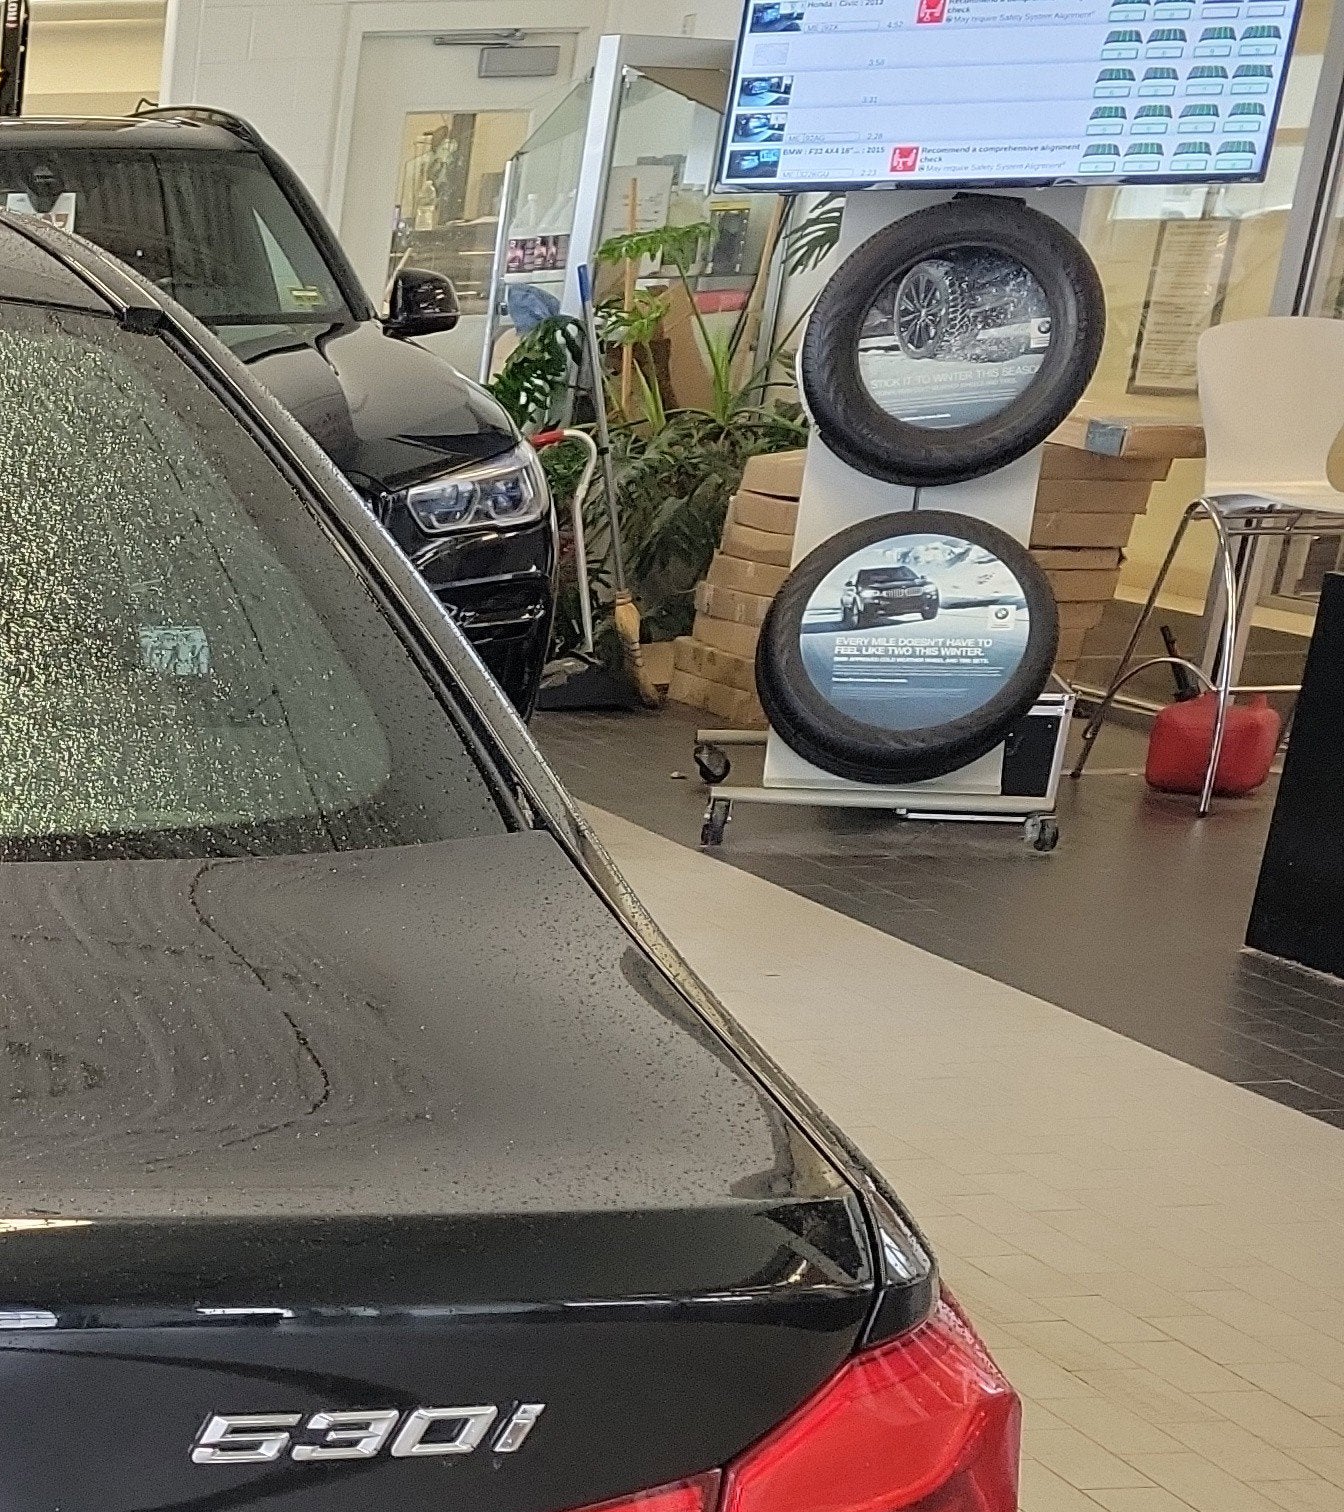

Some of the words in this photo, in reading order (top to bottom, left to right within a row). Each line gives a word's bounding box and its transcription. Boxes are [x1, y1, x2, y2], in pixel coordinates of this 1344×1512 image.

[979, 145, 1039, 154] comprehensive
[1041, 143, 1081, 152] alignment
[871, 378, 900, 390] STICK
[916, 375, 932, 385] TO
[935, 371, 973, 383] WINTER
[977, 368, 1000, 379] THIS
[836, 637, 871, 646] EVERY
[871, 638, 896, 646] MILE
[898, 638, 945, 646] DOESN'T
[946, 638, 976, 647] HAVE
[978, 639, 993, 647] TO
[862, 647, 885, 655] LIKE
[887, 647, 913, 655] TWO
[915, 647, 940, 656] THIS
[191, 1403, 546, 1464] 530i
